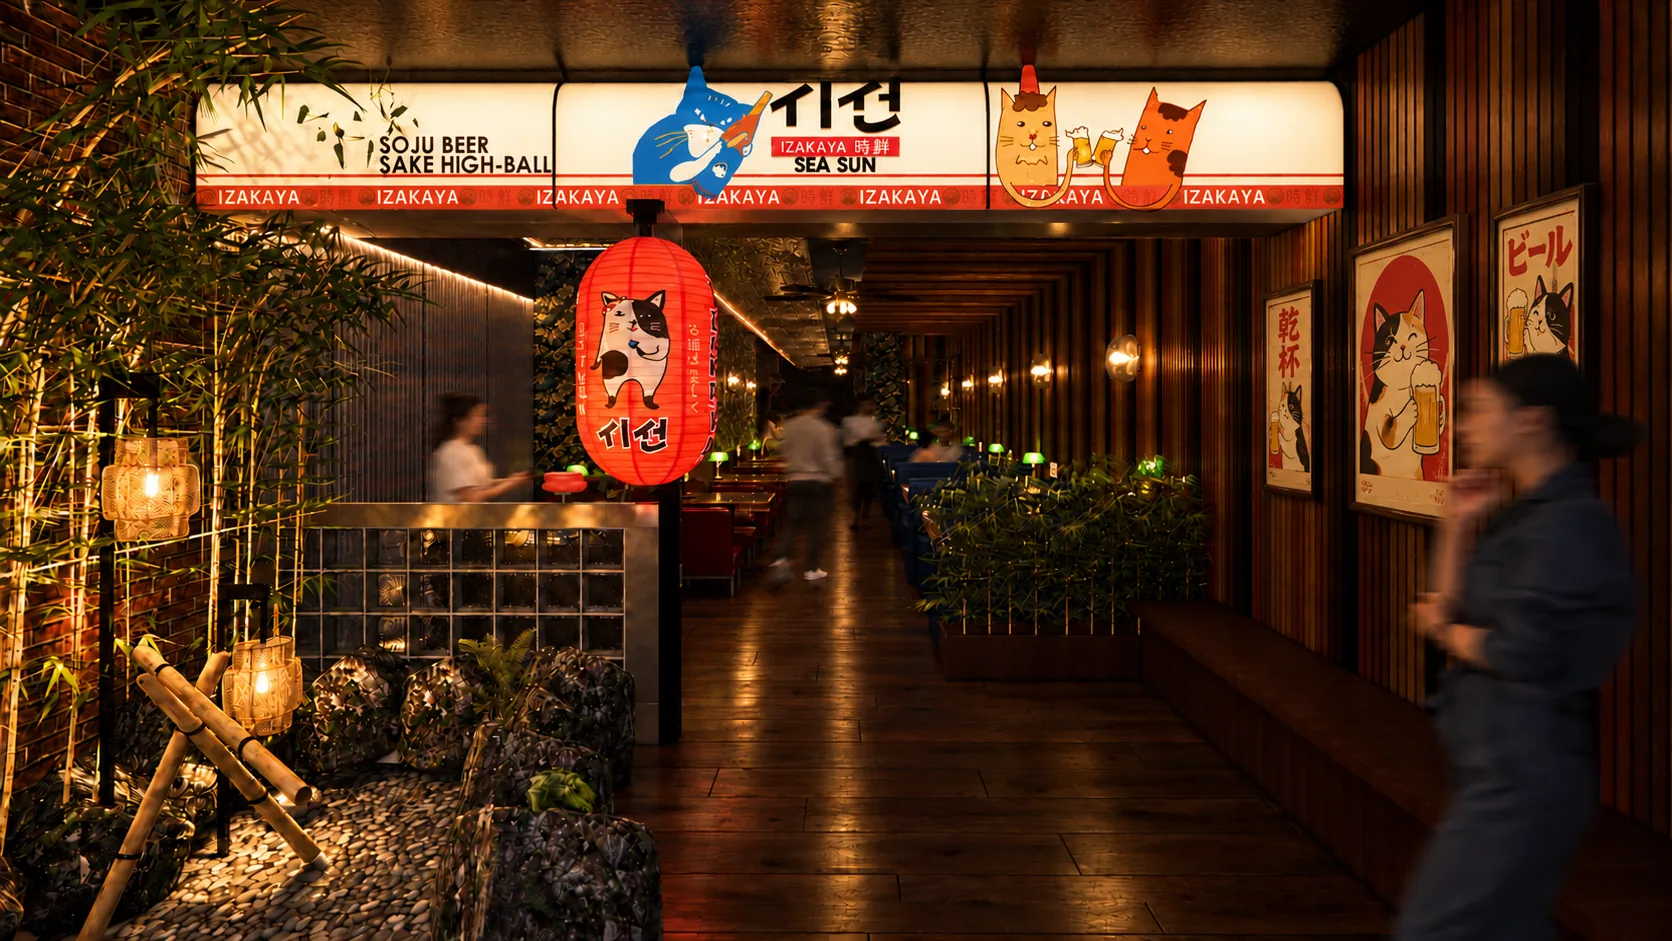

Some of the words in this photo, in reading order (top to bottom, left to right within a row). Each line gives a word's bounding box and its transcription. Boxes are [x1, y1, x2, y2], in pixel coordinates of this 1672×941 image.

[379, 136, 434, 154] SOJU
[442, 136, 489, 154] BEER
[780, 140, 847, 154] IZAKAYA
[379, 155, 434, 174] SAKE
[441, 155, 552, 174] HIGH-BALL
[794, 156, 830, 173] SEA
[837, 156, 876, 173] SUN
[218, 189, 300, 205] IZAKAYA
[377, 189, 459, 205] IZAKAYA
[537, 189, 619, 205] IZAKAYA
[859, 189, 942, 205] IZAKAYA
[1183, 189, 1265, 205] IZAKAYA
[1508, 225, 1573, 276] ビール
[1278, 306, 1300, 378] 乾杯
